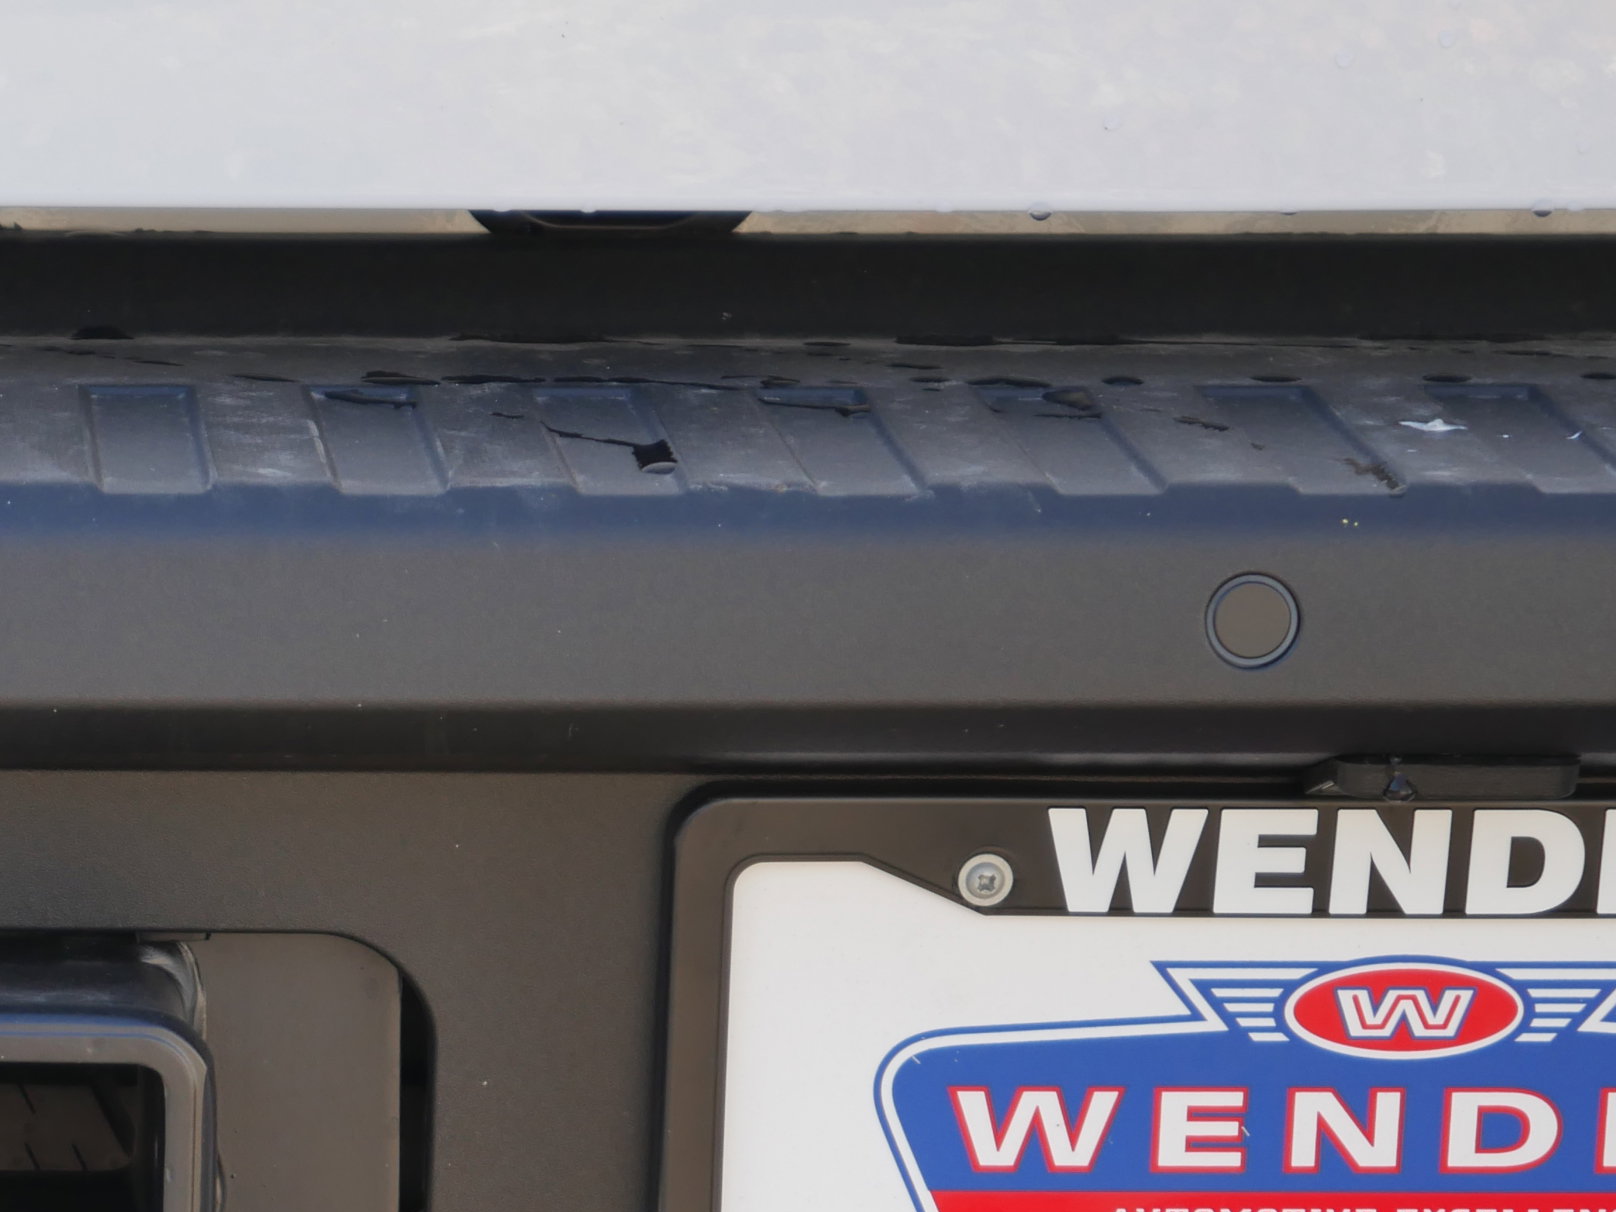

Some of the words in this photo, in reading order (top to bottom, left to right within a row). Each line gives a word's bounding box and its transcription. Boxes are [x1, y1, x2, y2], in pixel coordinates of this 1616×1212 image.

[1048, 807, 1616, 916] WEND
[1336, 987, 1477, 1040] W
[947, 1085, 1616, 1174] WEND
